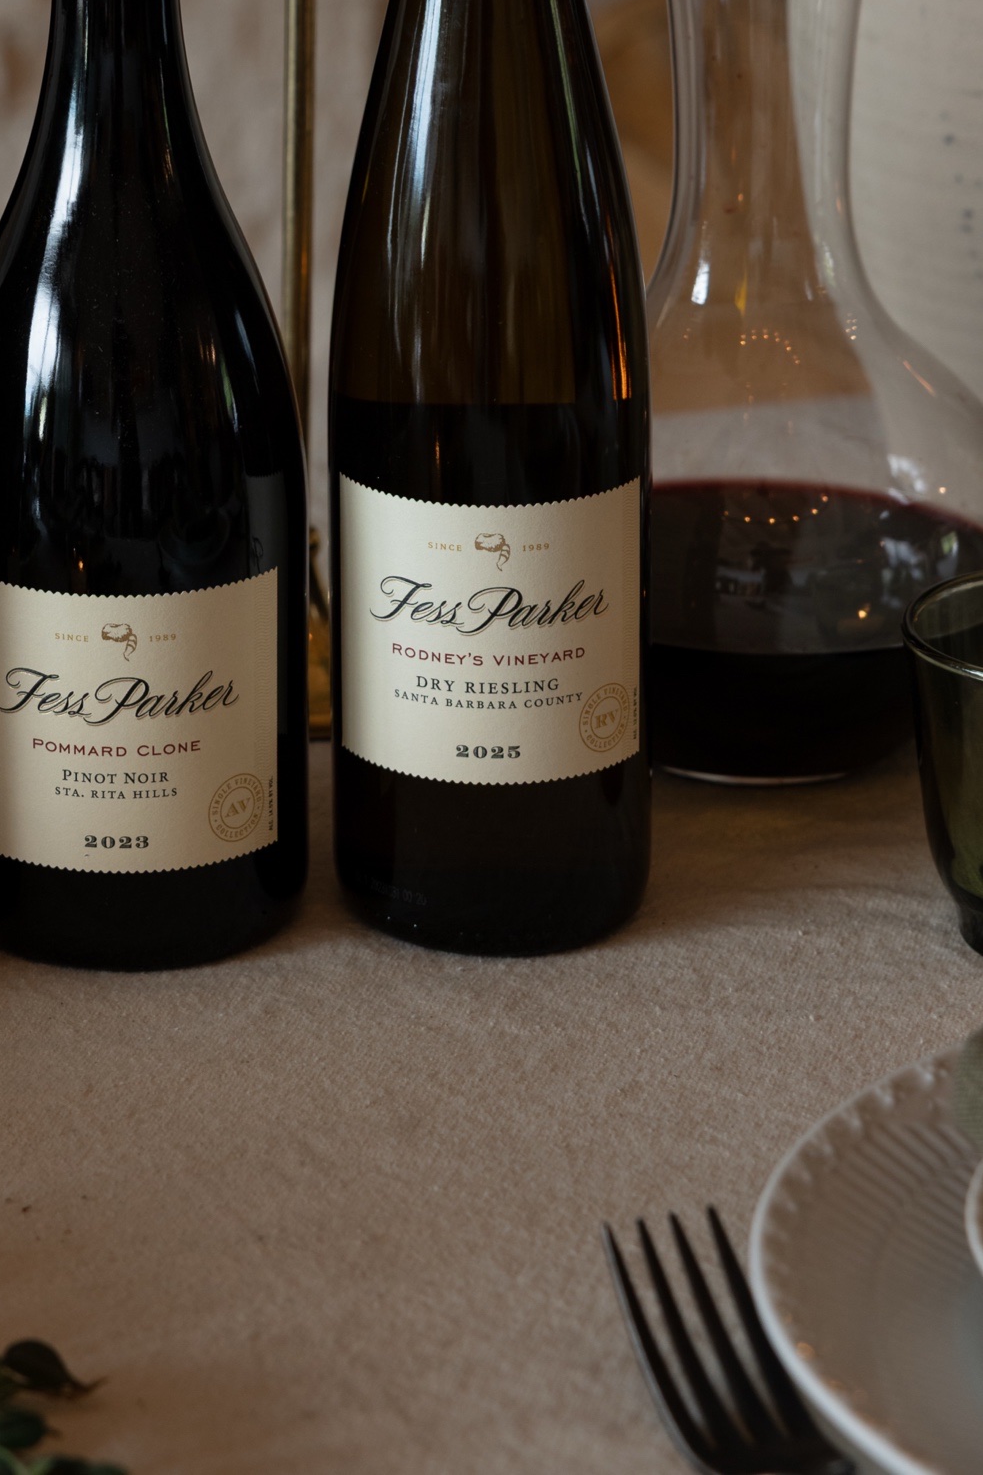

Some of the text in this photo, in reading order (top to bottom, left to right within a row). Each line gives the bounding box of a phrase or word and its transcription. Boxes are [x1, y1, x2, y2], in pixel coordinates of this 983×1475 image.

[428, 541, 550, 552] SINCE 1989
[369, 575, 609, 634] Fess Parker
[55, 632, 177, 642] SINCE 1989
[392, 642, 586, 666] RODNEY'S VINEYARD
[416, 675, 560, 694] DRY RIESLING
[83, 670, 239, 726] Parker
[394, 688, 583, 710] SANTA BARBARA COUNTY
[32, 738, 201, 757] POMMARD CLONE
[456, 744, 521, 759] 2025
[62, 769, 169, 784] PINOT NOIR
[55, 786, 177, 800] STA. RITA HILLS
[224, 797, 251, 818] AV
[84, 834, 150, 849] 2023
